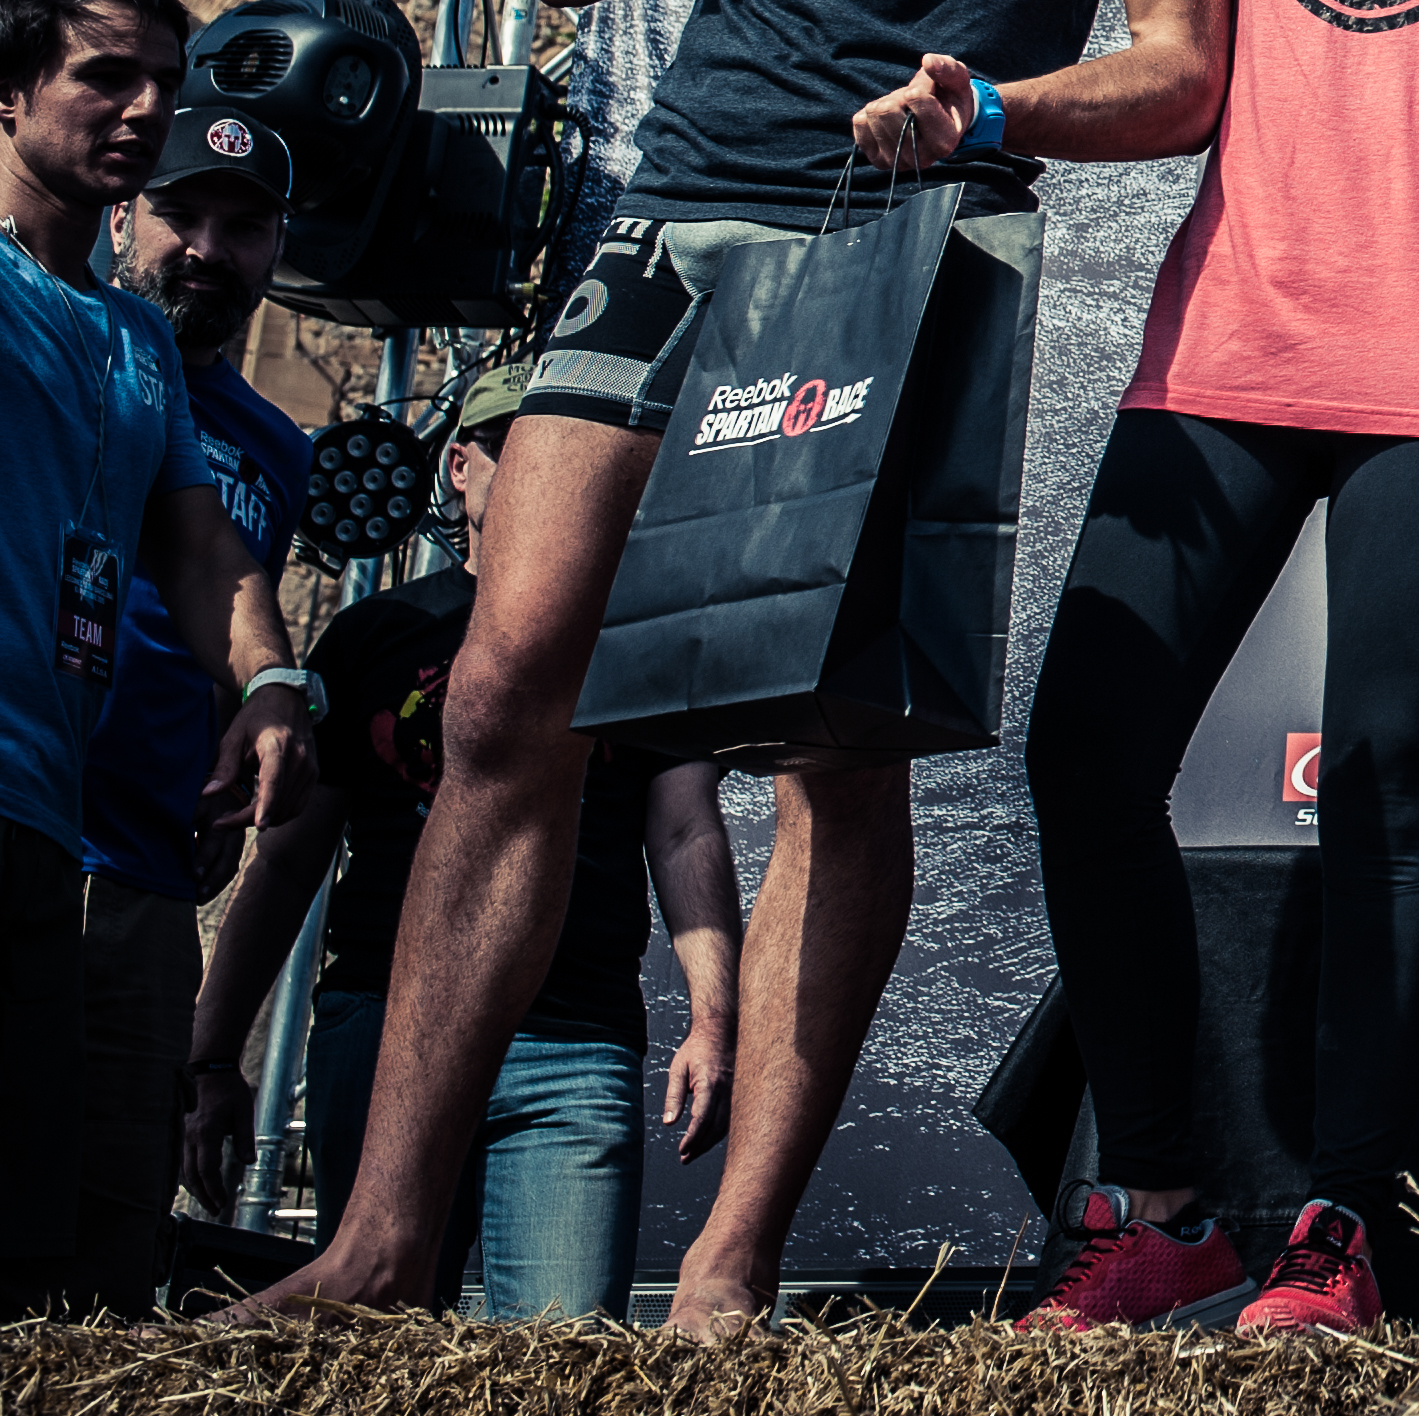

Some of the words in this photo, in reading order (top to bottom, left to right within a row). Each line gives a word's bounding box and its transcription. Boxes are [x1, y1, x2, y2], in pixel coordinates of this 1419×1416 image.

[694, 400, 789, 446] SPARTAN
[821, 376, 875, 422] RACE
[707, 372, 798, 411] Reebok
[200, 430, 244, 459] Reebok
[210, 469, 267, 541] TAFF
[73, 615, 102, 647] TEAM
